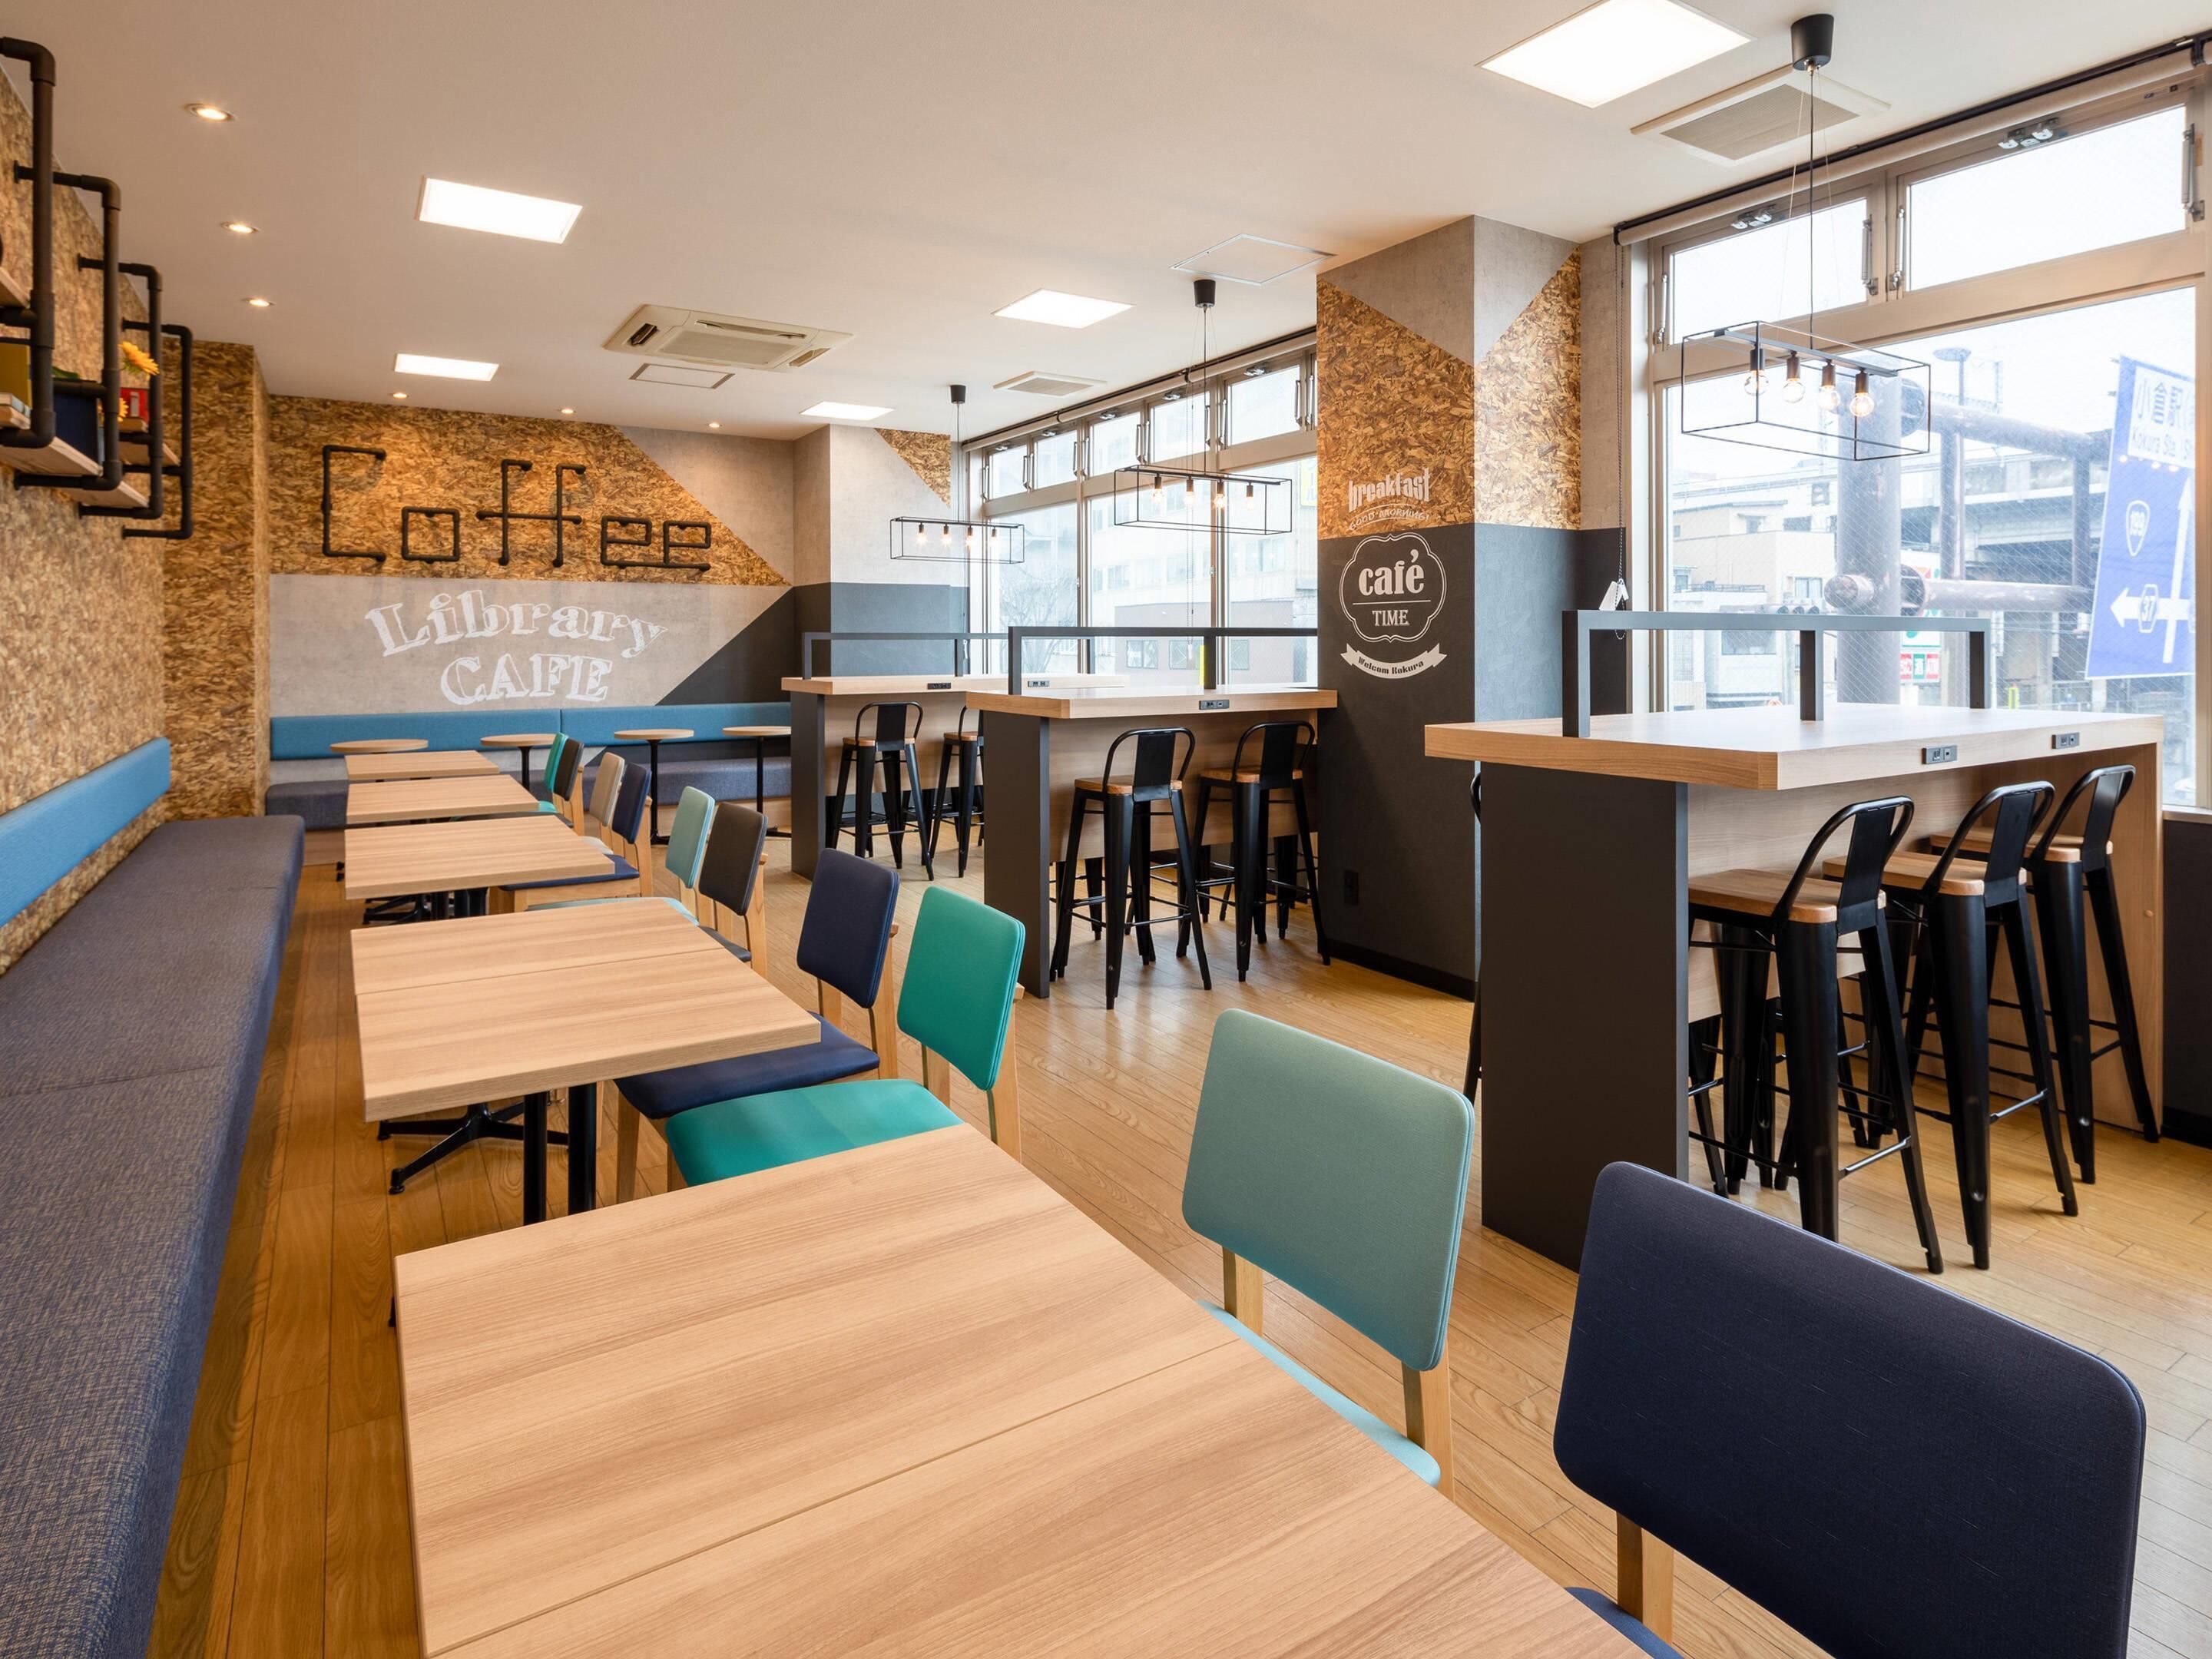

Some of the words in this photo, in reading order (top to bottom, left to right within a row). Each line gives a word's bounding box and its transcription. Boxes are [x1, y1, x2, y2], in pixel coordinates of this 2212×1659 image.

[321, 443, 713, 573] Coffee
[1349, 468, 1430, 513] breakfast
[1349, 512, 1375, 530] GOOD
[1359, 549, 1425, 596] café
[365, 588, 670, 659] Library
[1372, 609, 1411, 628] TIME
[2141, 595, 2156, 621] 37
[440, 654, 614, 706] CAFE
[1358, 657, 1389, 674] Welcom
